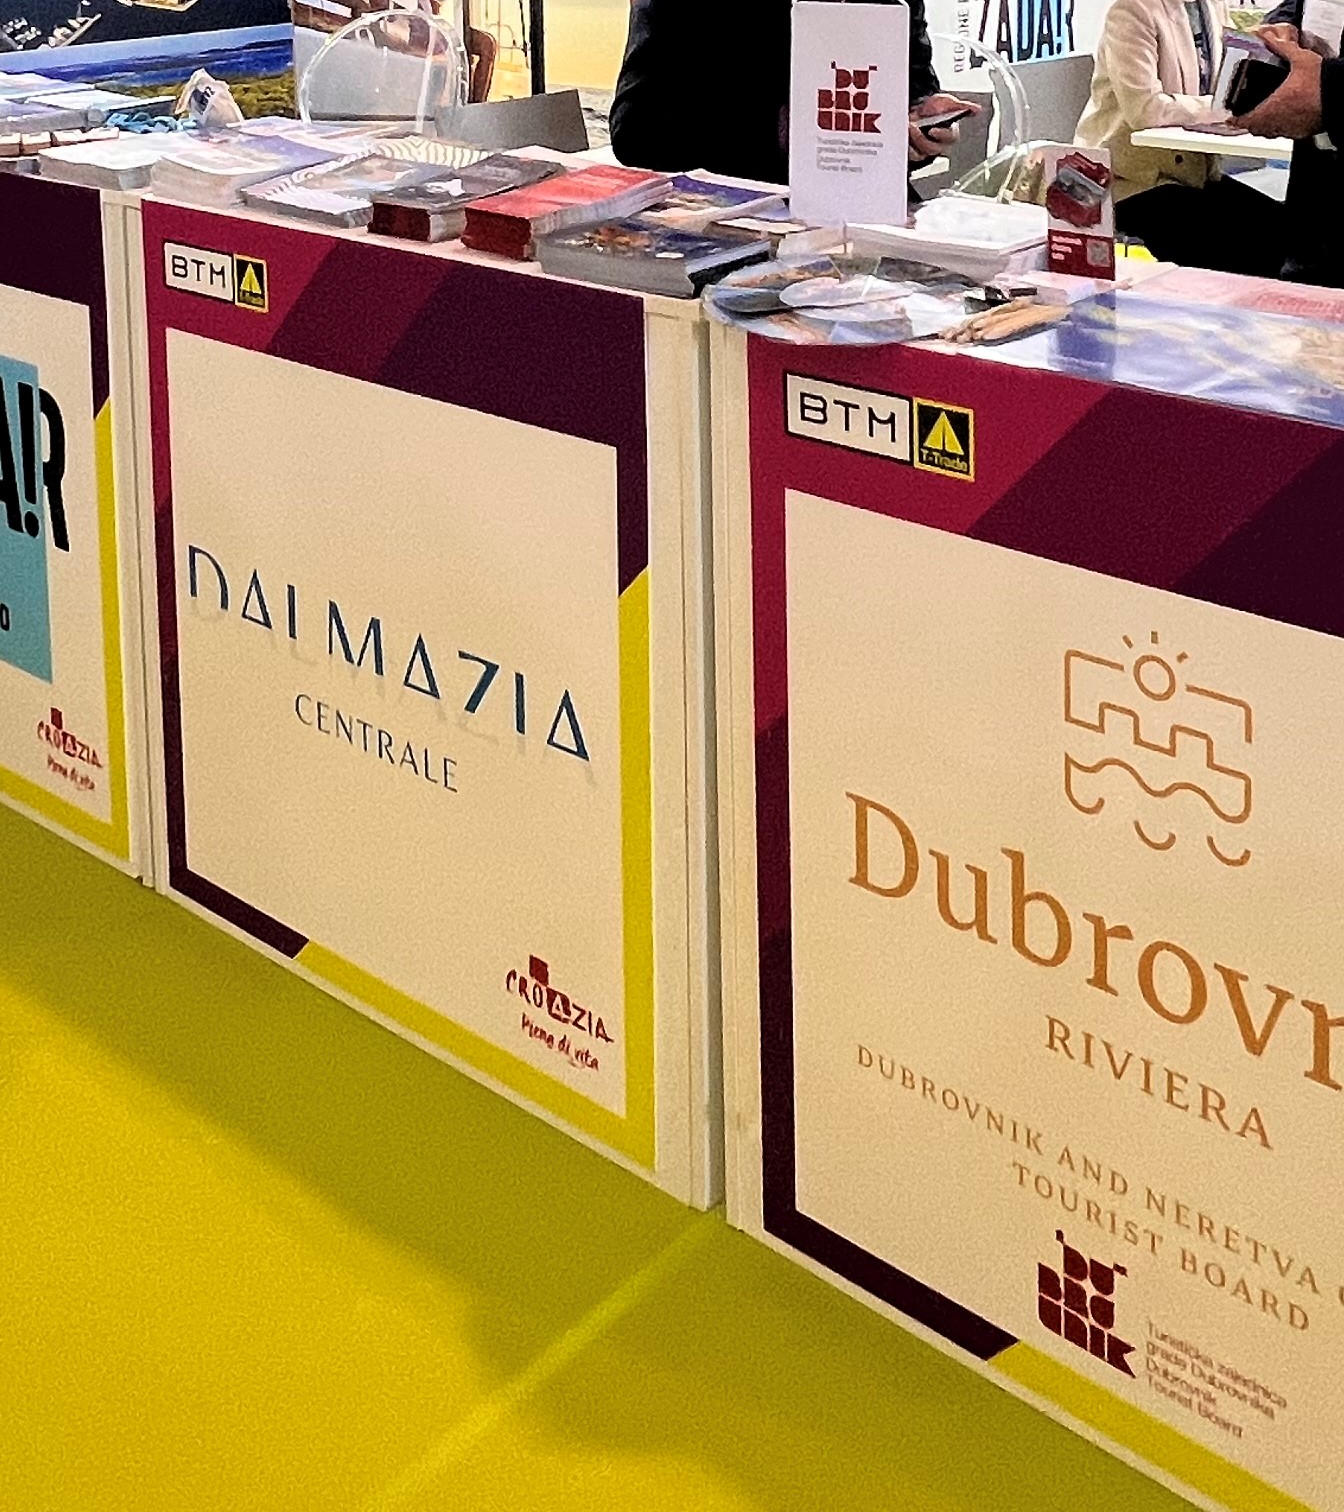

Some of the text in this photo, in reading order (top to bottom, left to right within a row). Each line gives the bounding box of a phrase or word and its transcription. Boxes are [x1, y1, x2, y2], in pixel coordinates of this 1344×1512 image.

[171, 254, 226, 289] BTM
[799, 391, 896, 443] BTM
[188, 544, 590, 762] DALMAZIA
[294, 693, 459, 794] CENTRALE
[506, 969, 614, 1043] CROAZIA
[1044, 1015, 1273, 1150] RIVIERA
[857, 1043, 1044, 1156] DUBROVNIK
[1057, 1146, 1129, 1197] AND
[1145, 1187, 1322, 1296] NERETVA
[1012, 1160, 1310, 1331] TOURIST BOARD
